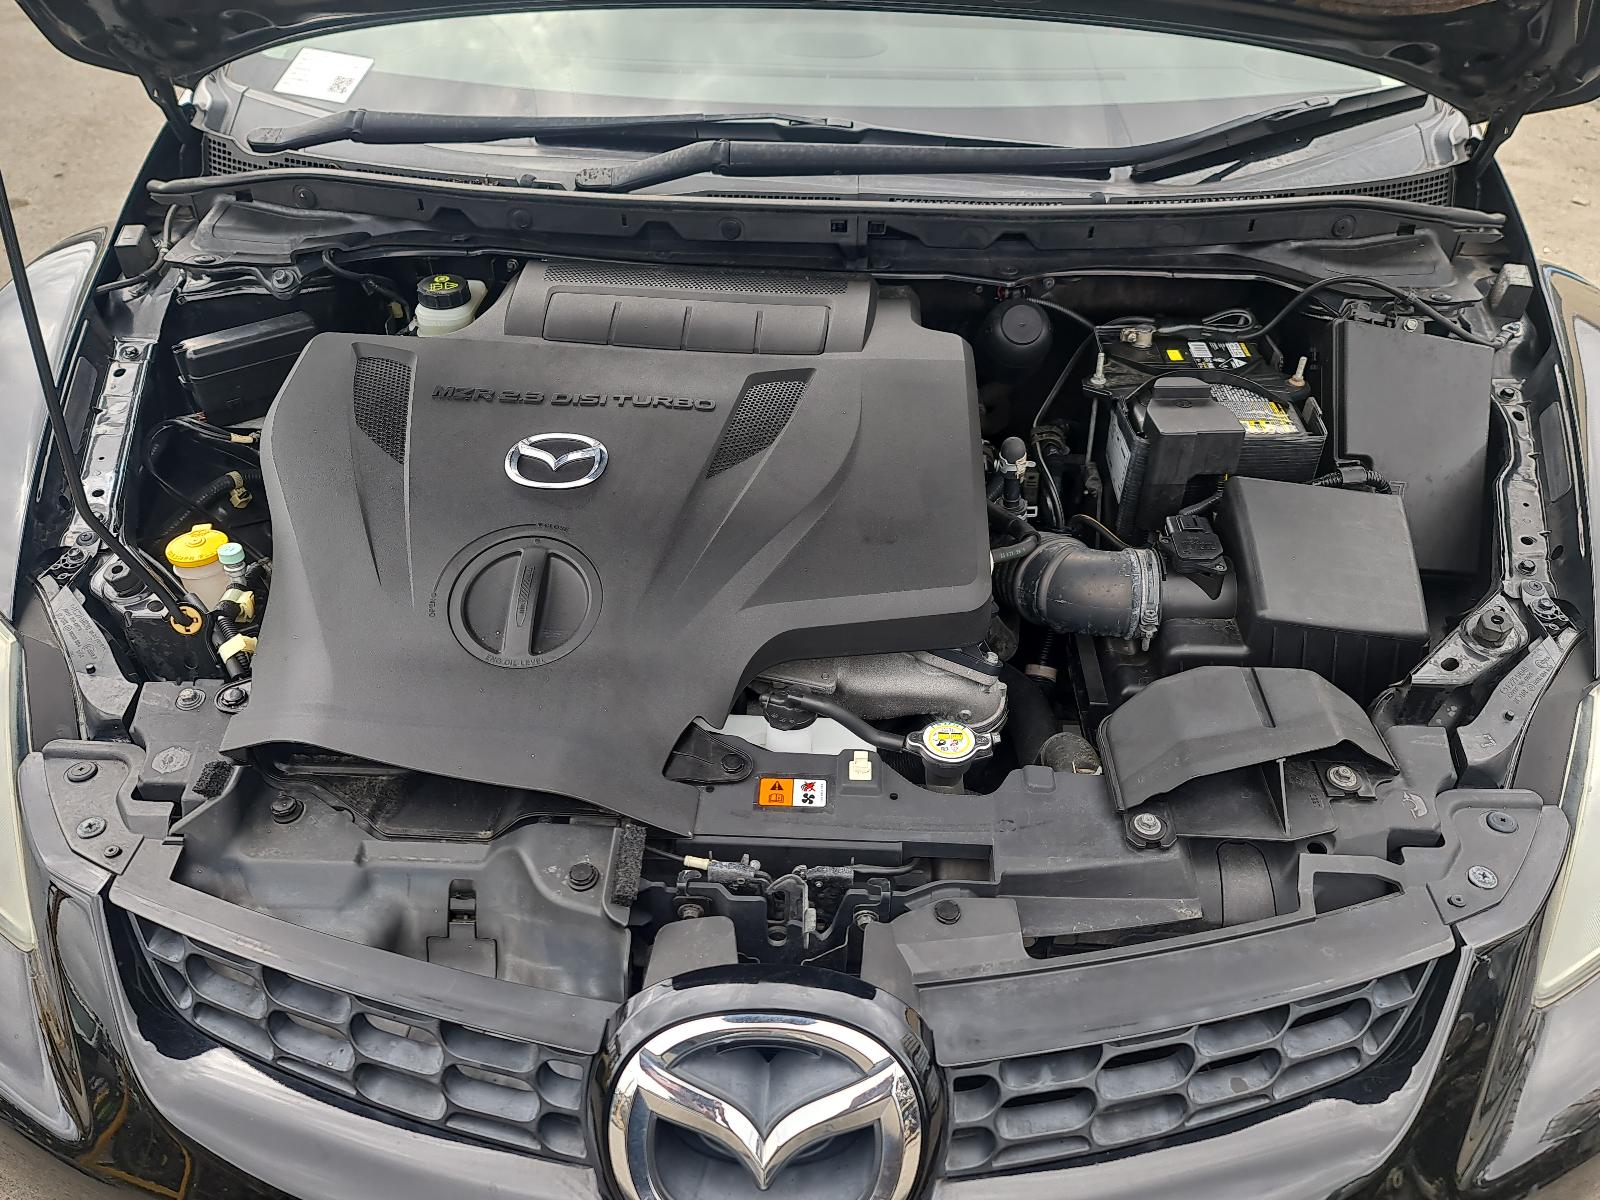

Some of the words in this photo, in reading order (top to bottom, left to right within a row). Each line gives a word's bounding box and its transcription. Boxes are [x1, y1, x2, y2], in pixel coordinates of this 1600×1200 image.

[432, 384, 496, 402] MZR
[498, 390, 545, 405] 2.3
[550, 392, 608, 407] DISI
[612, 393, 717, 412] TURBO
